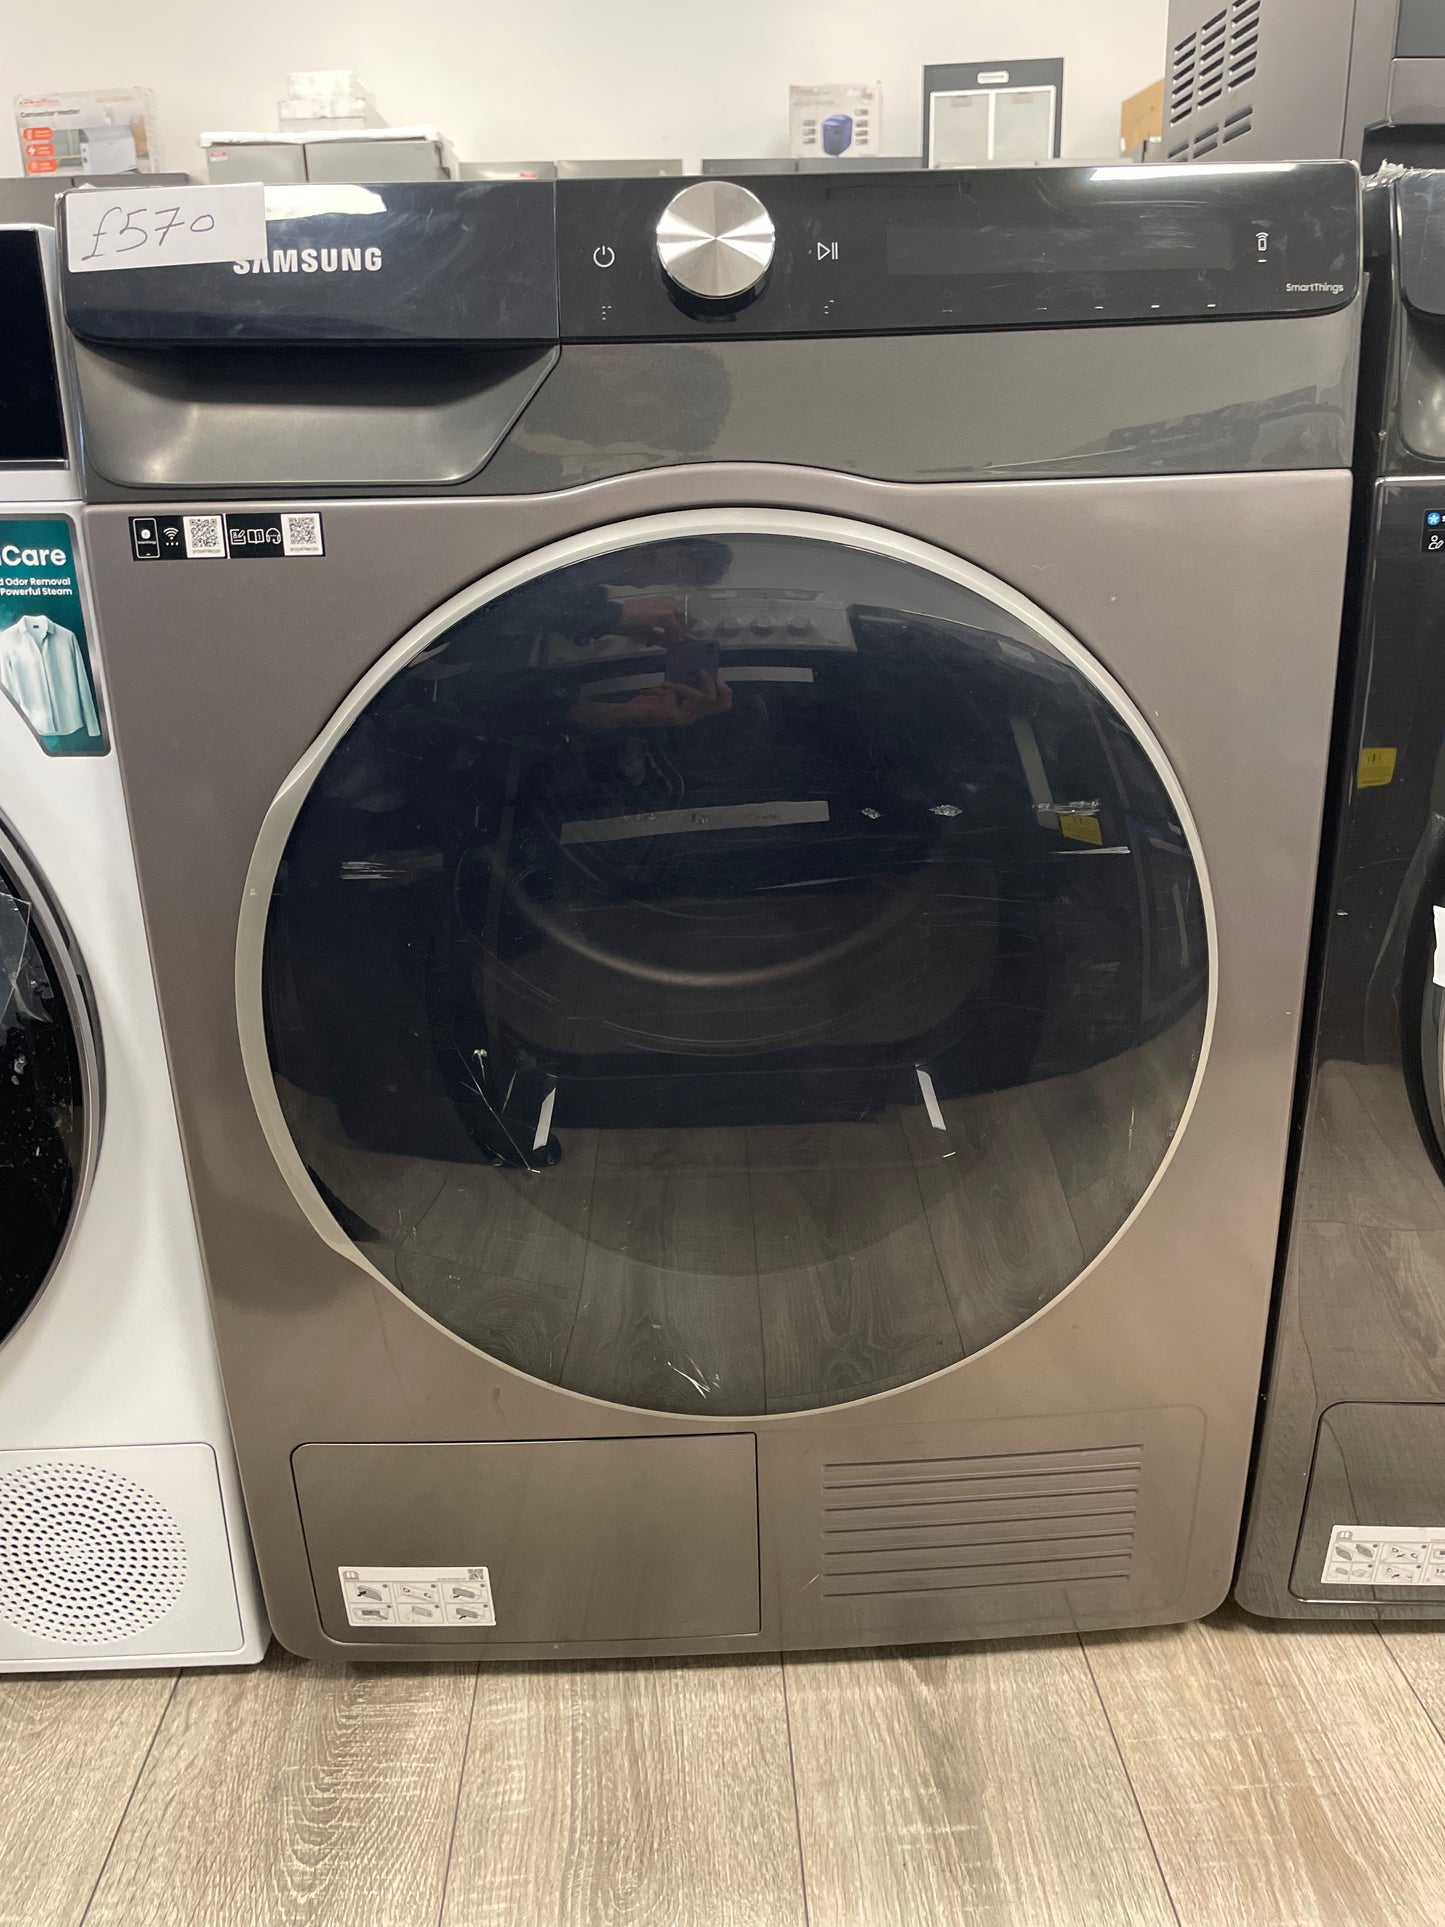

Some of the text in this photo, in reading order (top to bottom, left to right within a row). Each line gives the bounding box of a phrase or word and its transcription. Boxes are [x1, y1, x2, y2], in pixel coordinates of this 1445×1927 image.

[81, 206, 215, 261] £570
[232, 247, 382, 275] SAMSUNG
[1286, 283, 1344, 294] SmartThings
[0, 545, 67, 566] Care
[5, 577, 28, 586] Odor
[30, 577, 71, 586] Removal
[0, 587, 73, 596] Powerful Steam
